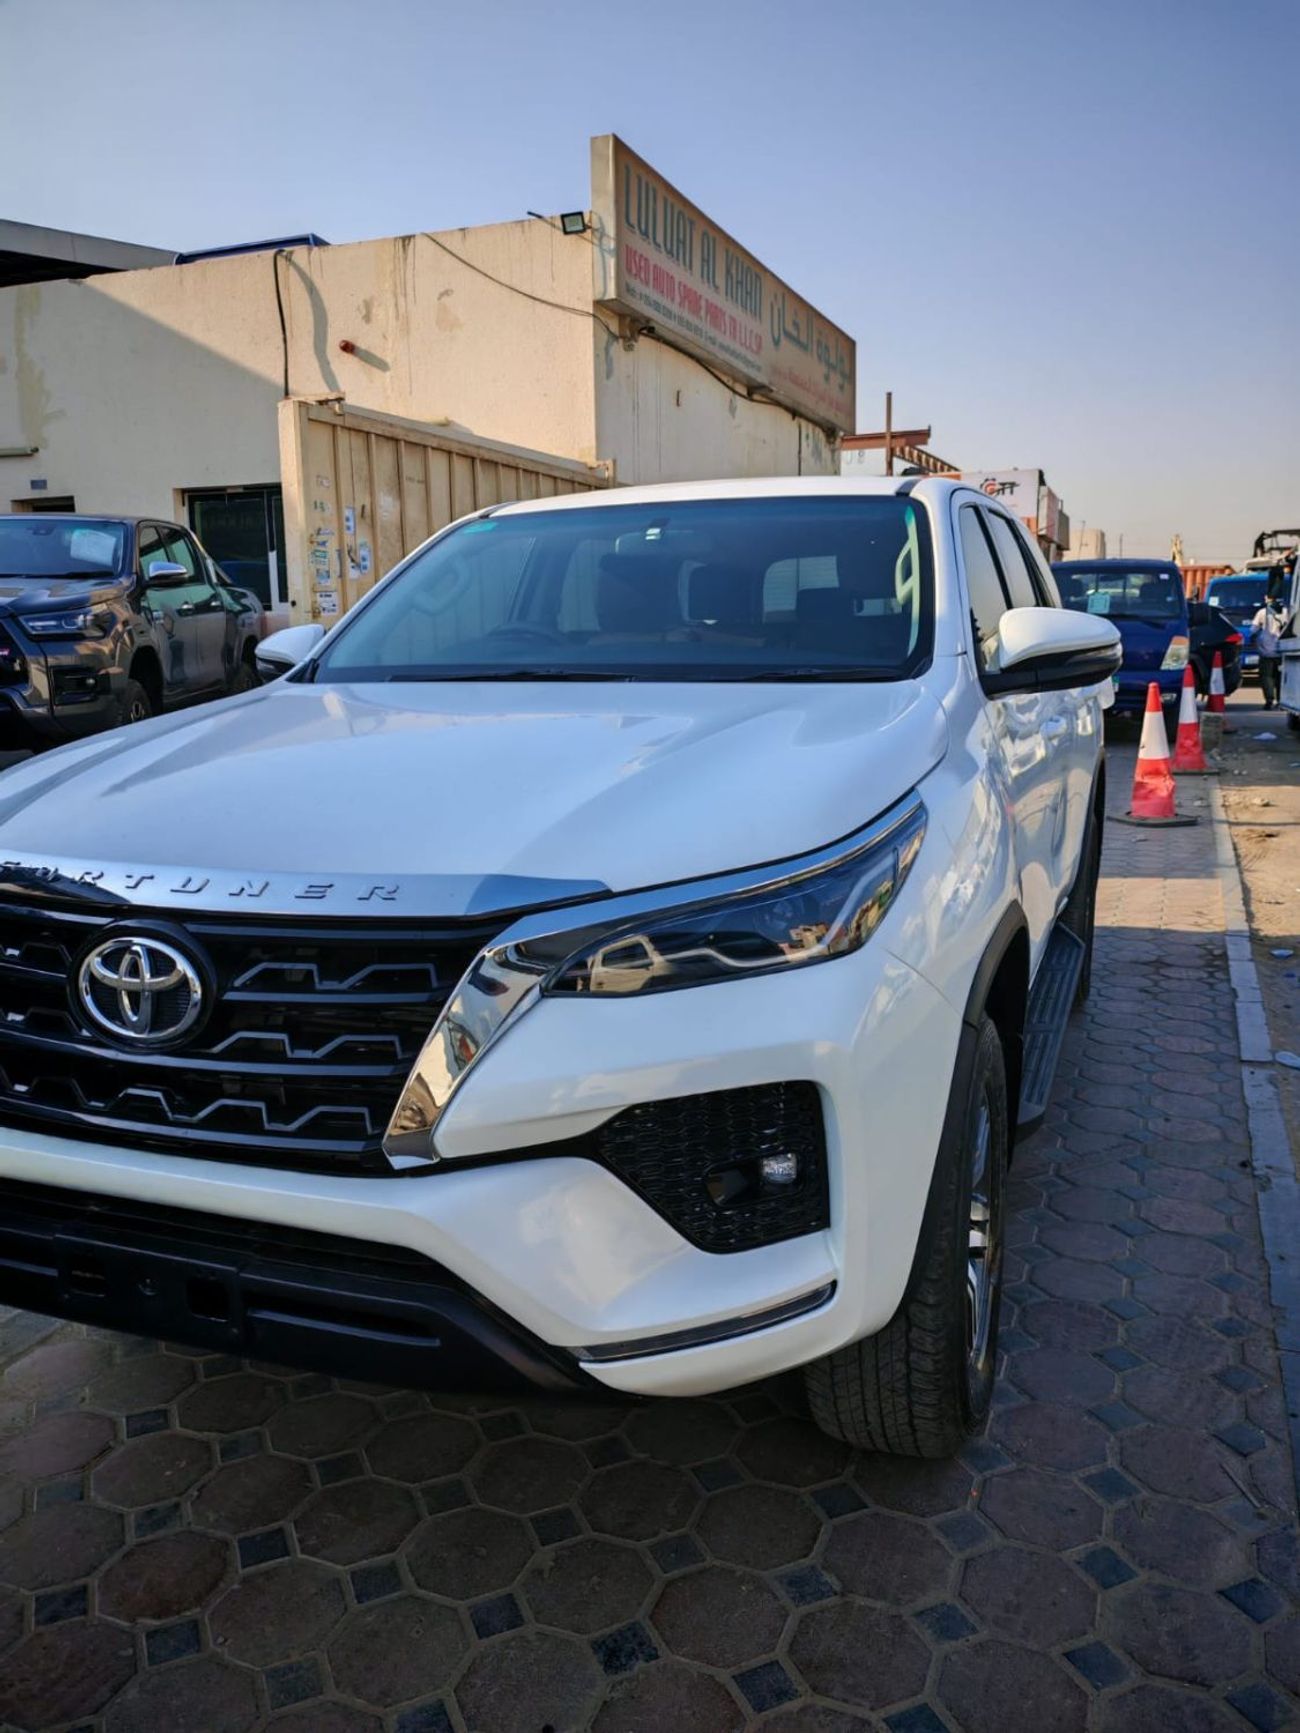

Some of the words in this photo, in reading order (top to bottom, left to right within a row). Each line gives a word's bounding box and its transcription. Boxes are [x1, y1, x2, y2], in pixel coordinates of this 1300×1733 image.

[624, 164, 695, 273] LULUAT
[701, 229, 719, 290] AL
[725, 248, 762, 322] KHAN
[625, 244, 649, 287] USED
[652, 263, 676, 302] AUTO
